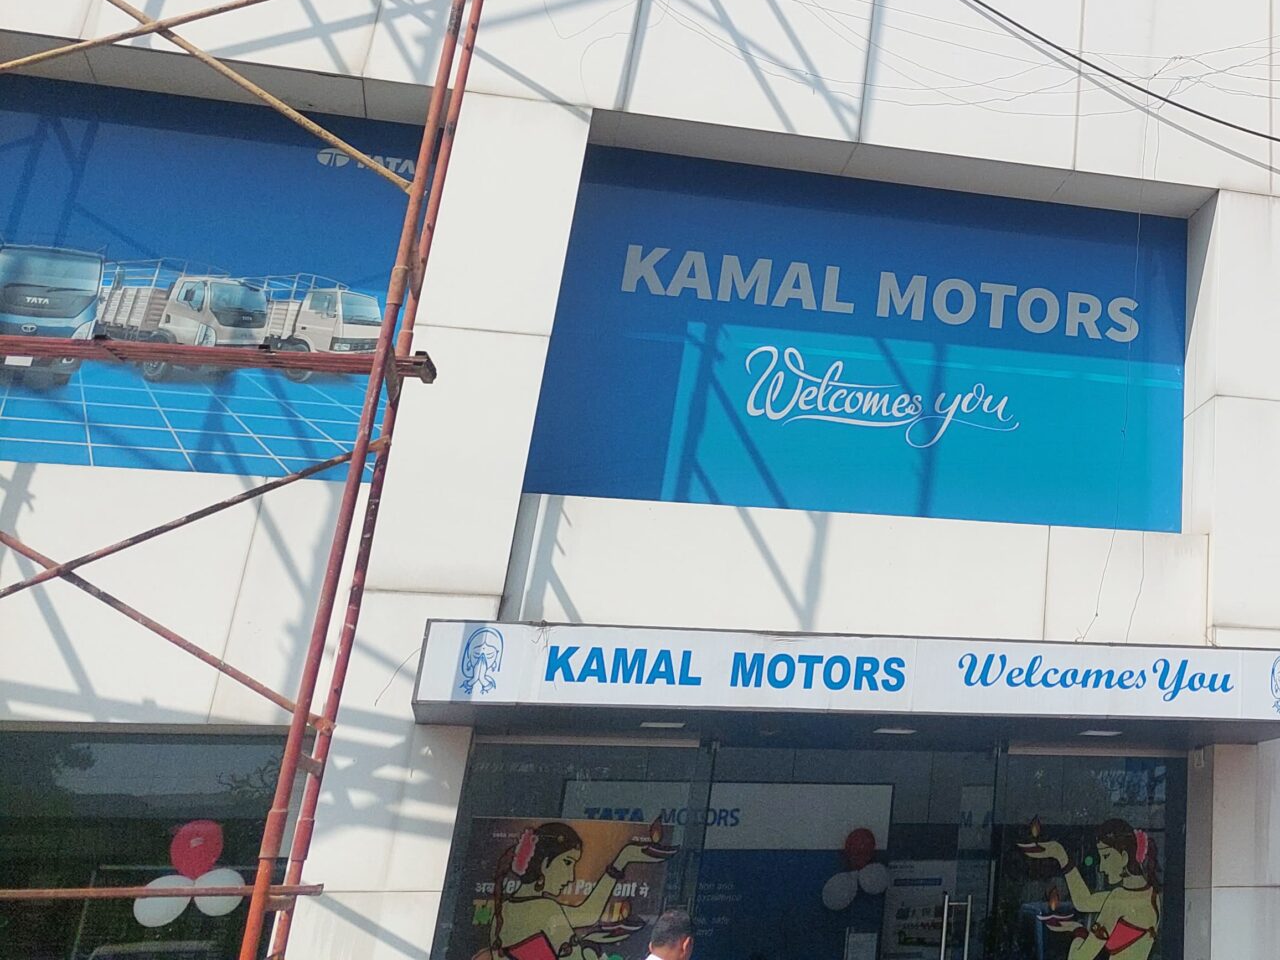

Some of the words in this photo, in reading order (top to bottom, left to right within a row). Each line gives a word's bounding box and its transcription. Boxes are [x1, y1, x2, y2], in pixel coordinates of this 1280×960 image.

[25, 296, 50, 304] TATA
[620, 244, 854, 314] KAMAL
[875, 271, 1139, 343] MOTORS
[744, 346, 923, 426] Welcomes
[905, 383, 1019, 448] you
[545, 645, 702, 686] KAMAL
[730, 652, 907, 692] MOTORS
[958, 652, 1148, 689] Welcomes
[1152, 658, 1234, 702] You
[574, 880, 637, 898] Paent
